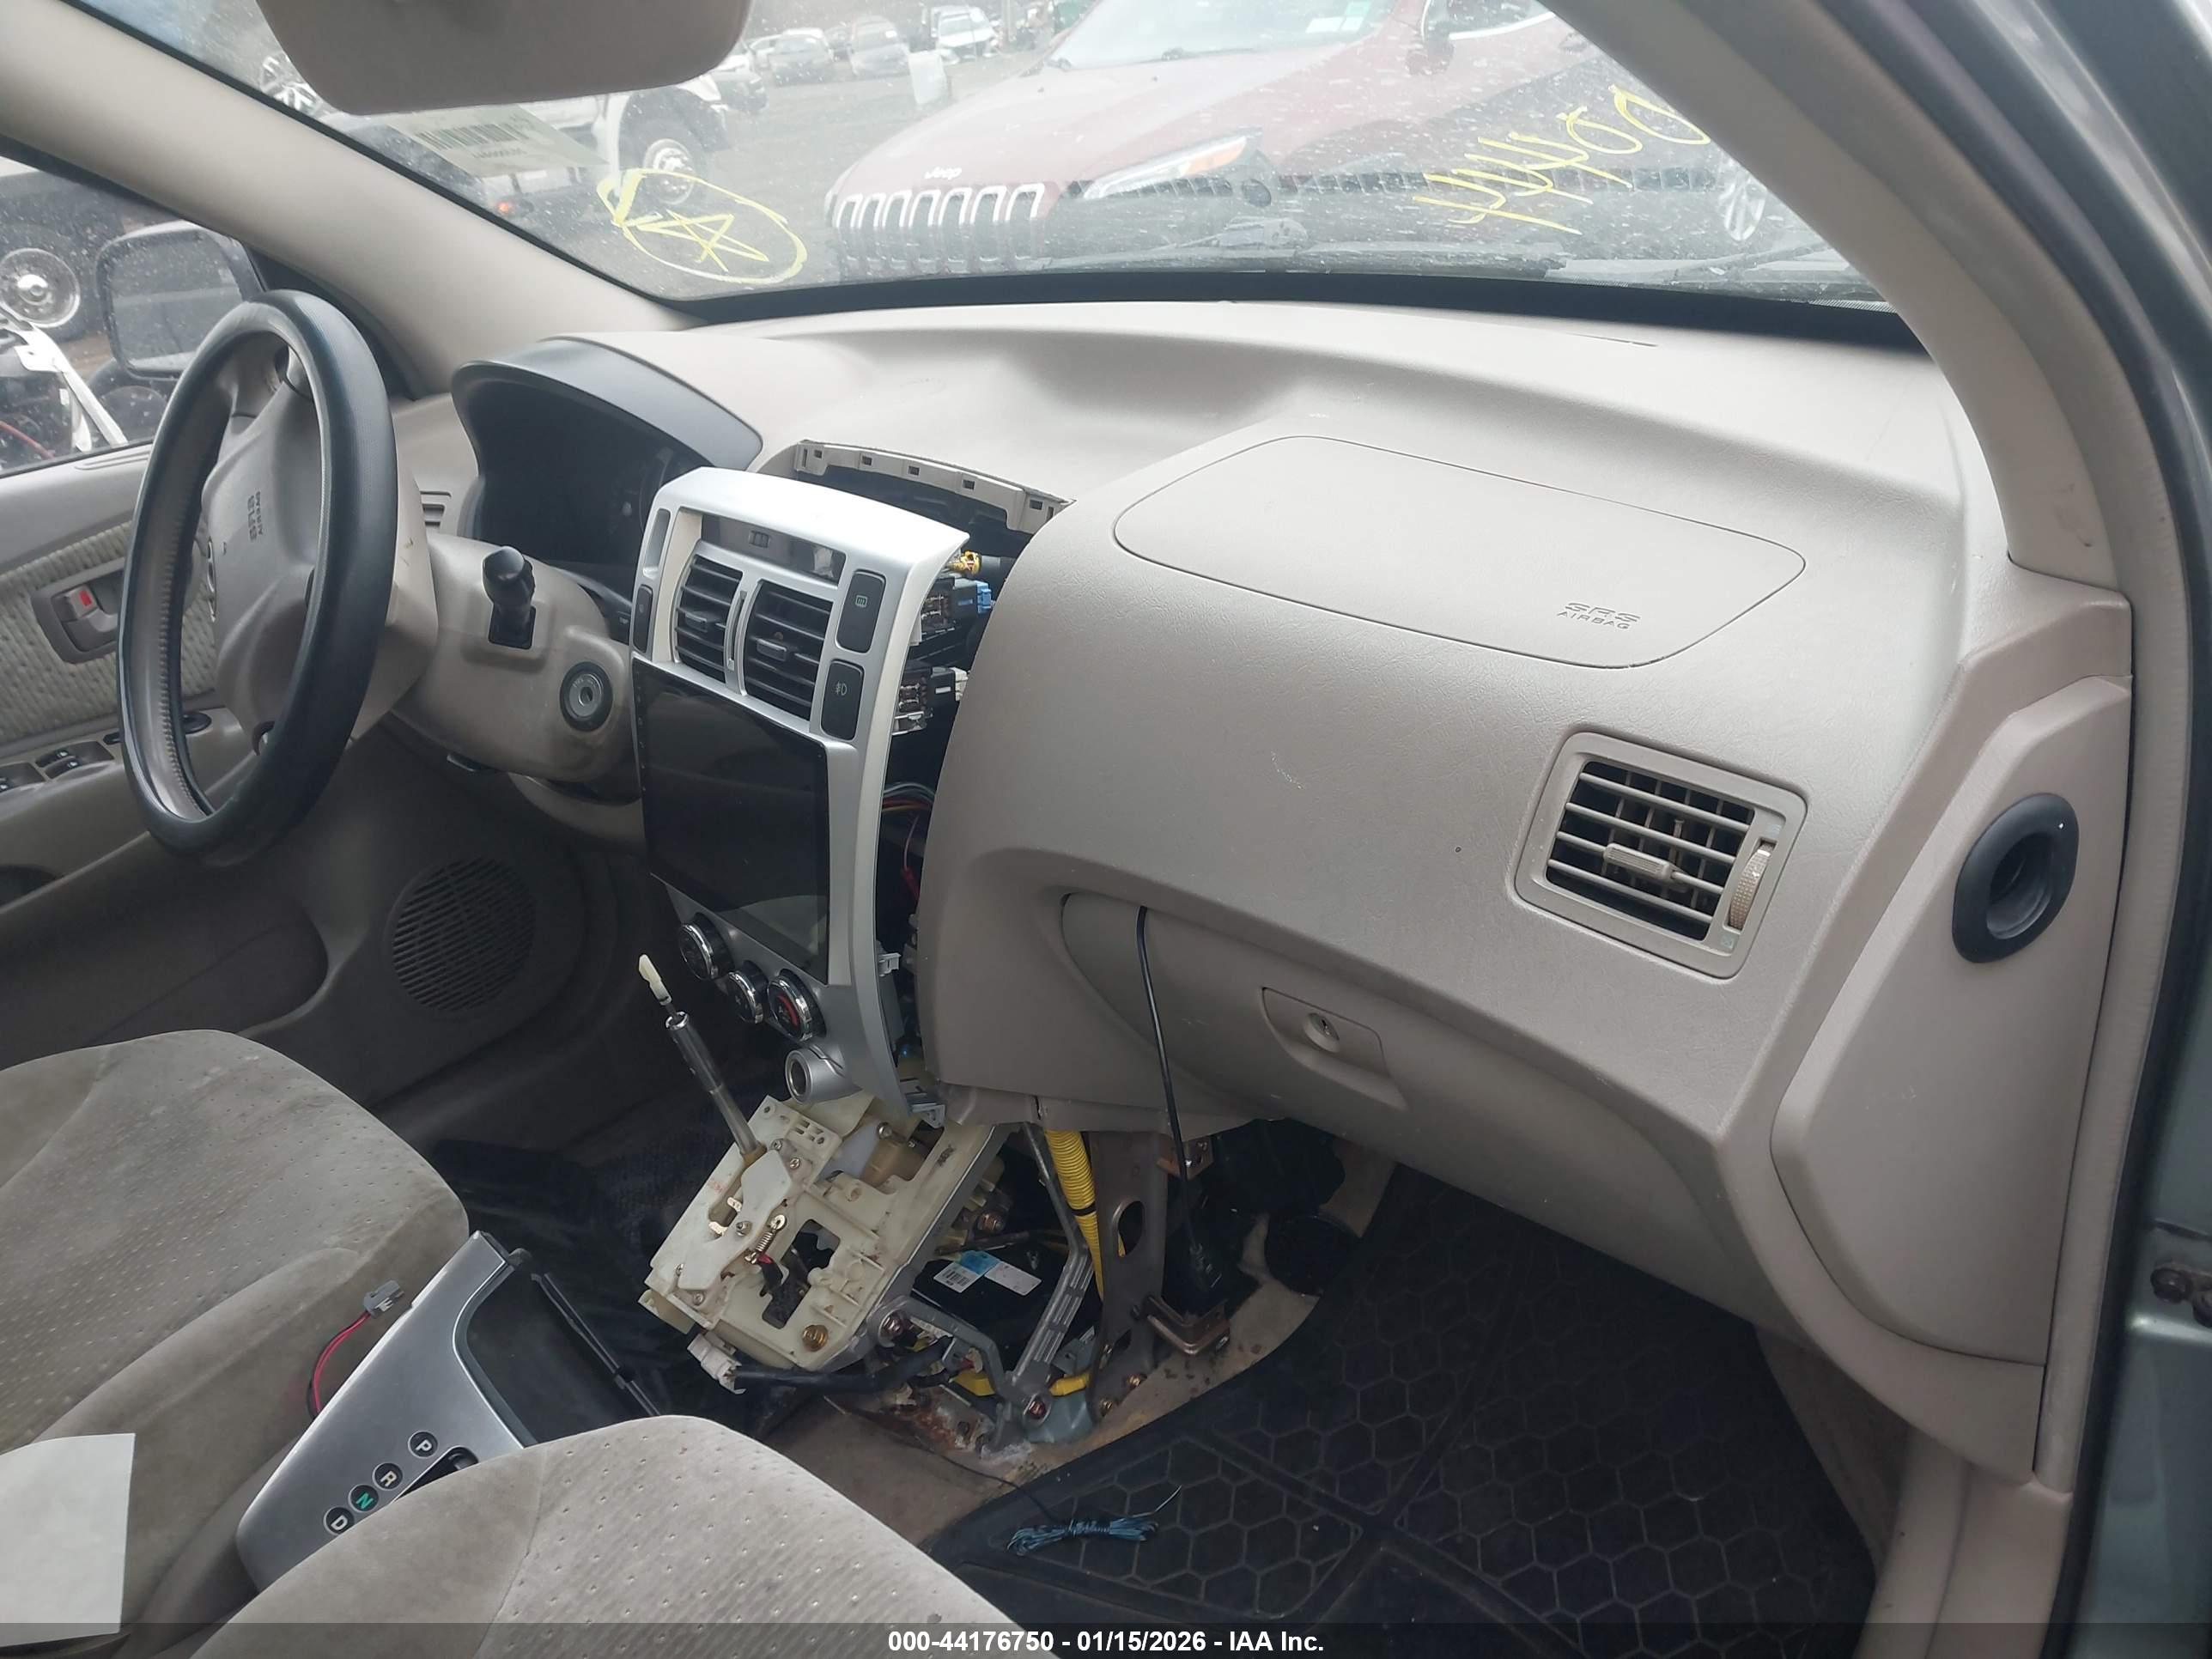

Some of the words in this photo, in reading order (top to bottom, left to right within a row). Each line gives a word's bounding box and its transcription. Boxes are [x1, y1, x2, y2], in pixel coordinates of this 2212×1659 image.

[924, 166, 963, 180] Jeep
[1556, 611, 1631, 629] AIRBAG
[1564, 602, 1642, 623] SRS
[415, 1438, 433, 1452] P
[380, 1469, 398, 1487] R
[355, 1492, 375, 1510] N
[330, 1514, 349, 1531] D
